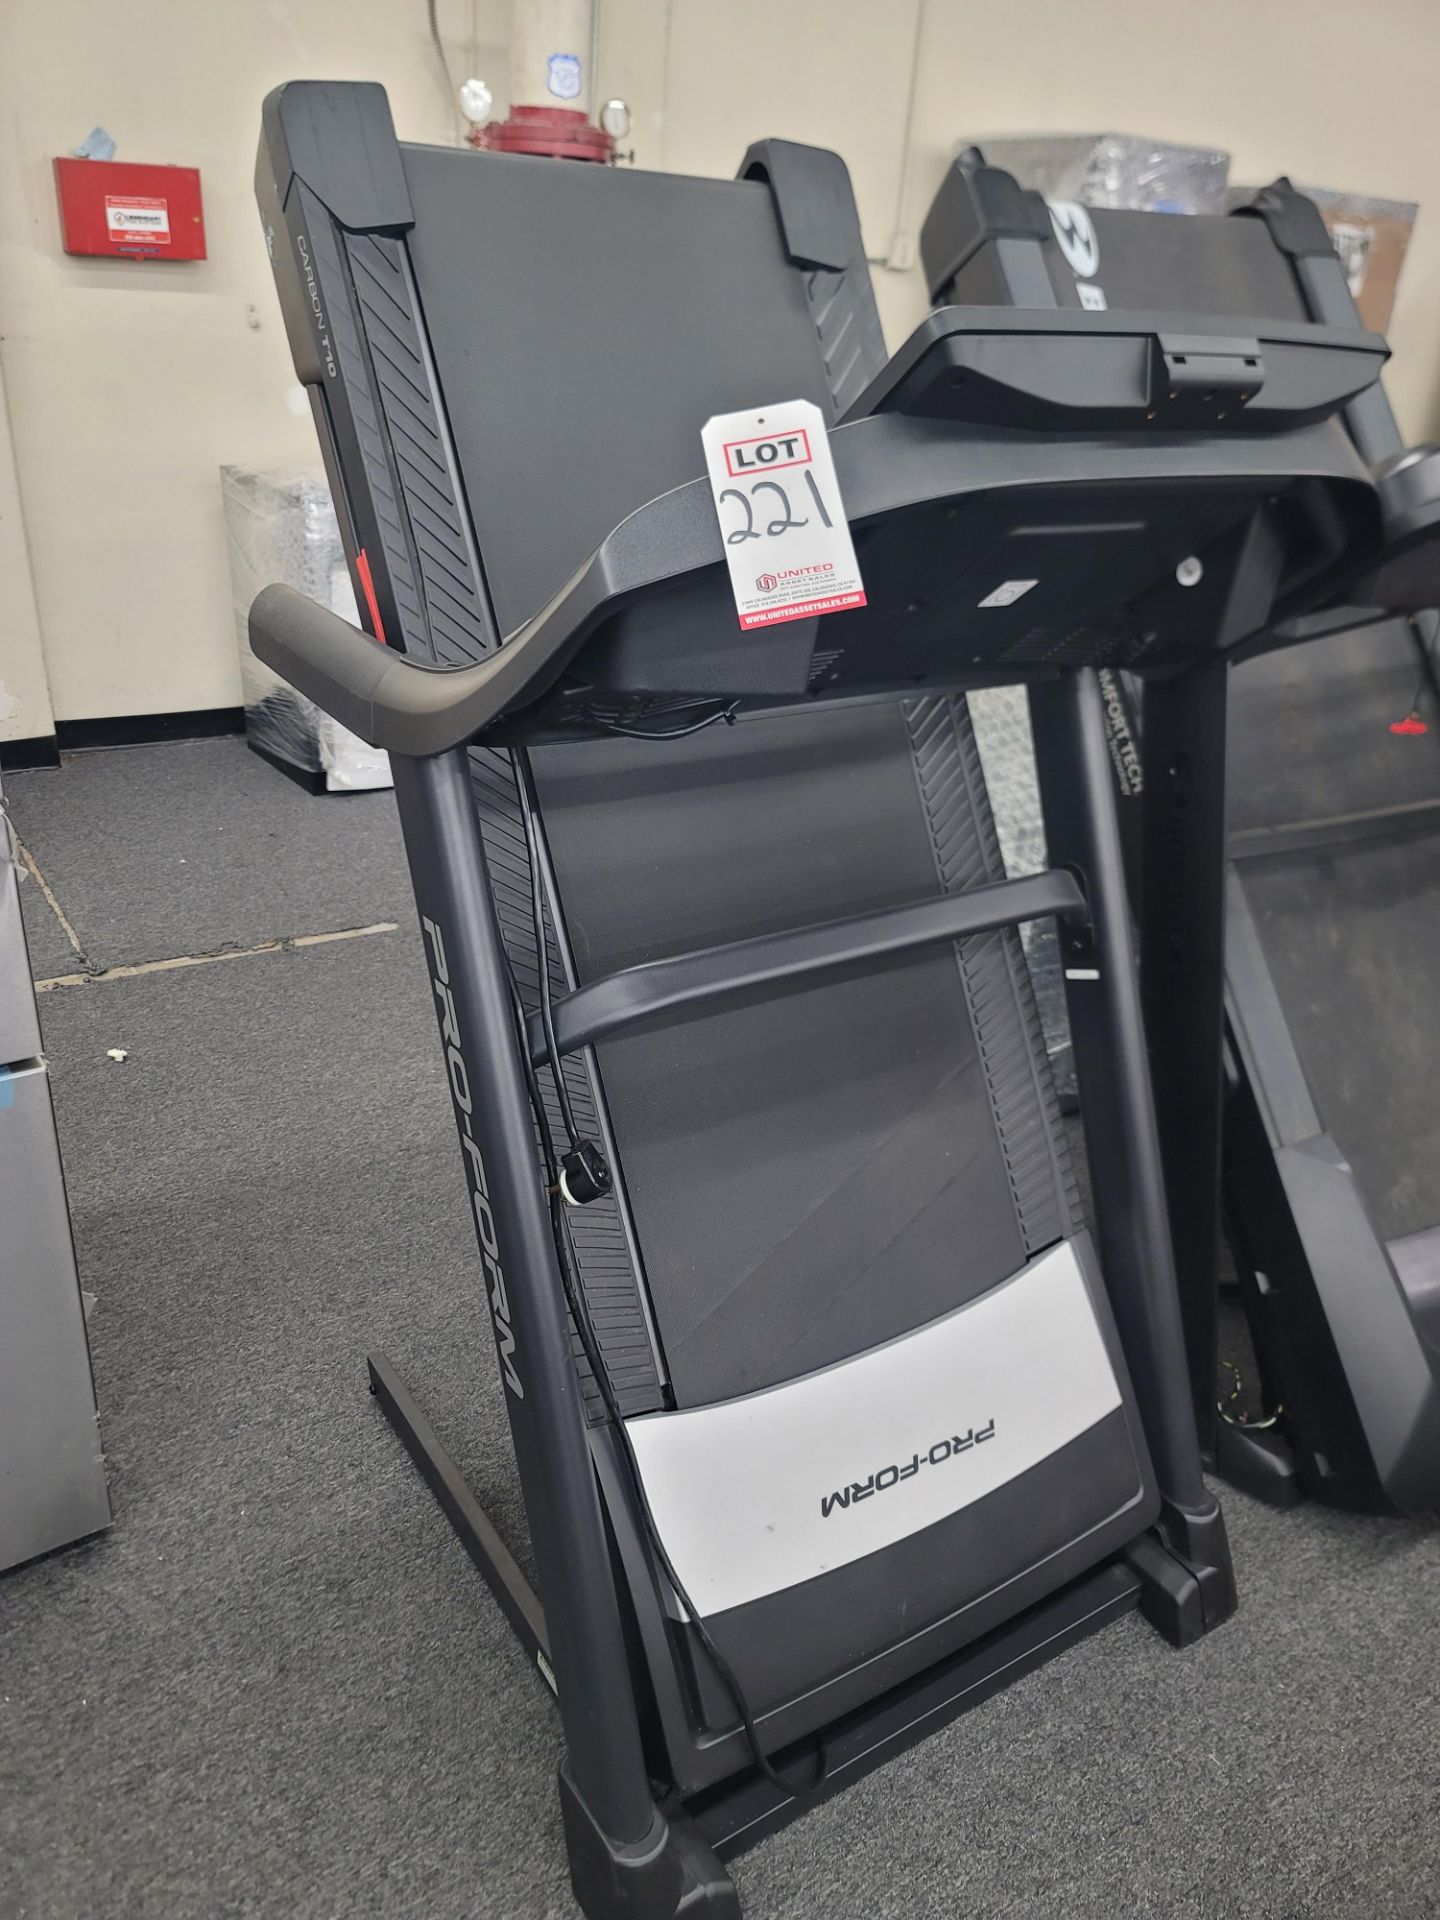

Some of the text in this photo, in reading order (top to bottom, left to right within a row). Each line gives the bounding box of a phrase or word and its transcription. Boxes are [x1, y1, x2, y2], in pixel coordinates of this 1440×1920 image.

[297, 235, 337, 379] CARBON T10
[735, 438, 798, 468] LOT
[719, 469, 833, 545] 221
[777, 563, 833, 579] UNITED
[780, 578, 807, 587] ASSET
[808, 573, 836, 581] SALES
[744, 594, 862, 625] WWW.UNITEDASSETSALES.COM
[1120, 741, 1143, 793] TECH
[422, 914, 524, 1400] PRO-FORM
[821, 1418, 996, 1518] PRO-FORM
